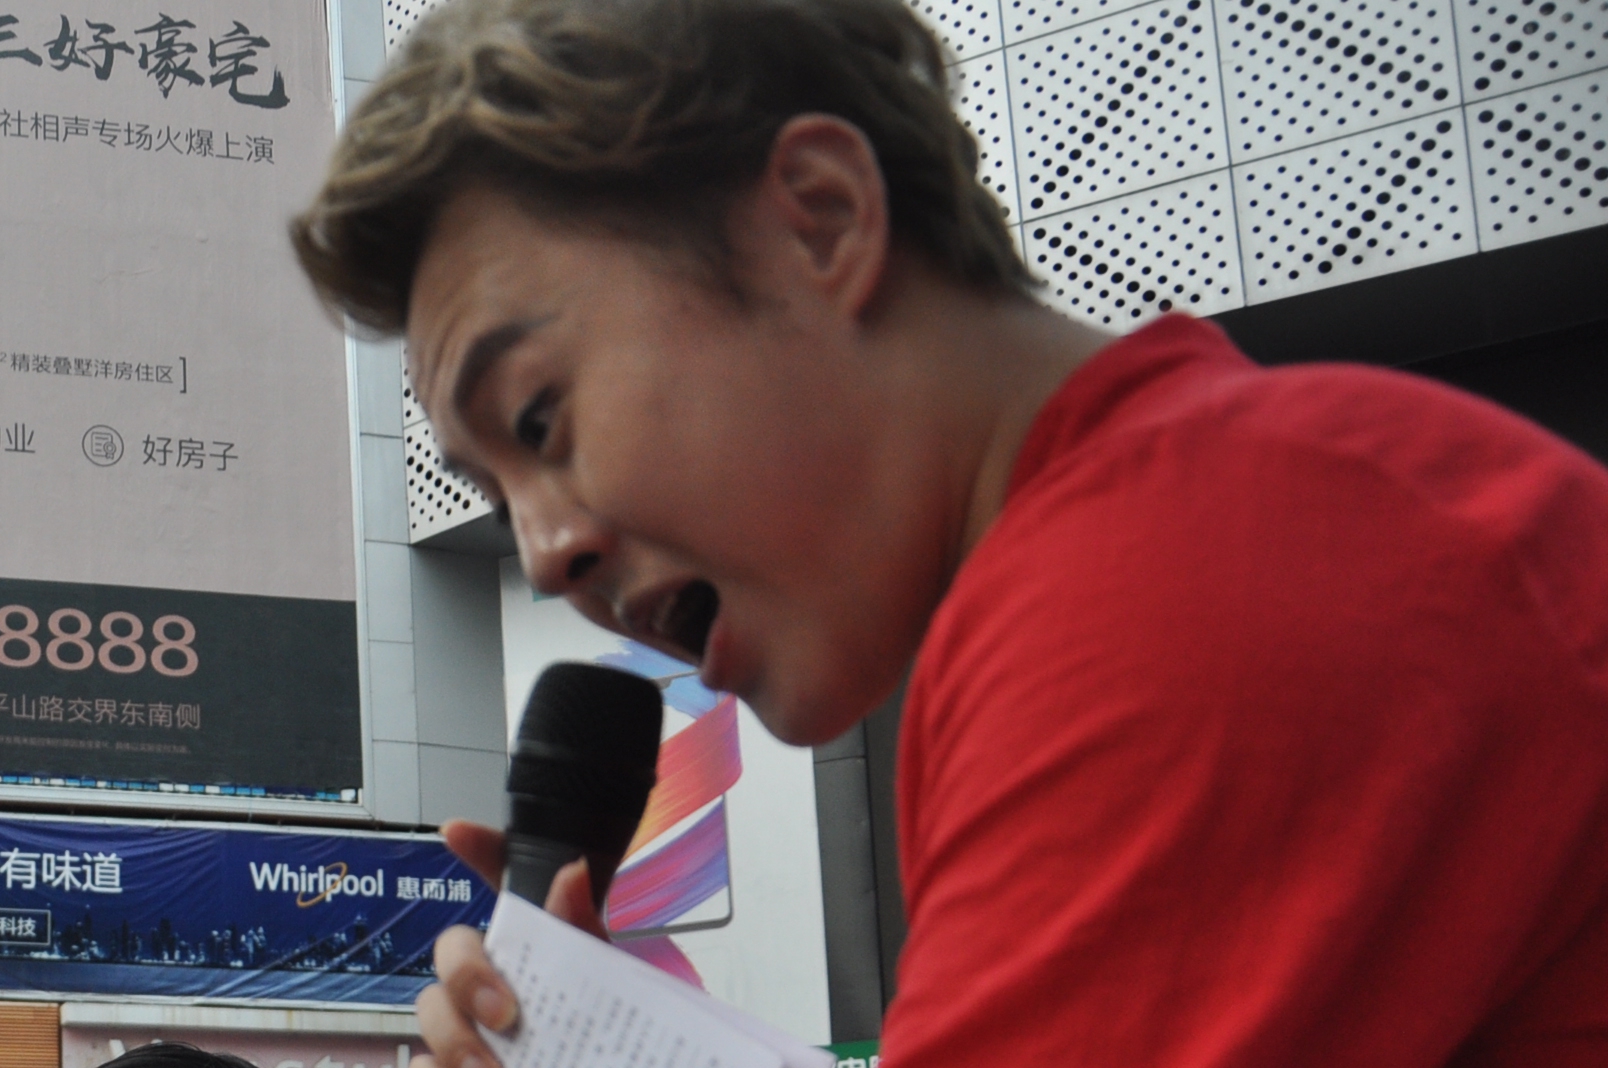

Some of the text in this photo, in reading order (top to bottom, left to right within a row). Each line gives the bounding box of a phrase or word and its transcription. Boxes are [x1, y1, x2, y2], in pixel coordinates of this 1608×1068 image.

[142, 433, 239, 472] 好房子
[249, 861, 472, 903] Whirlpool 惠而浦
